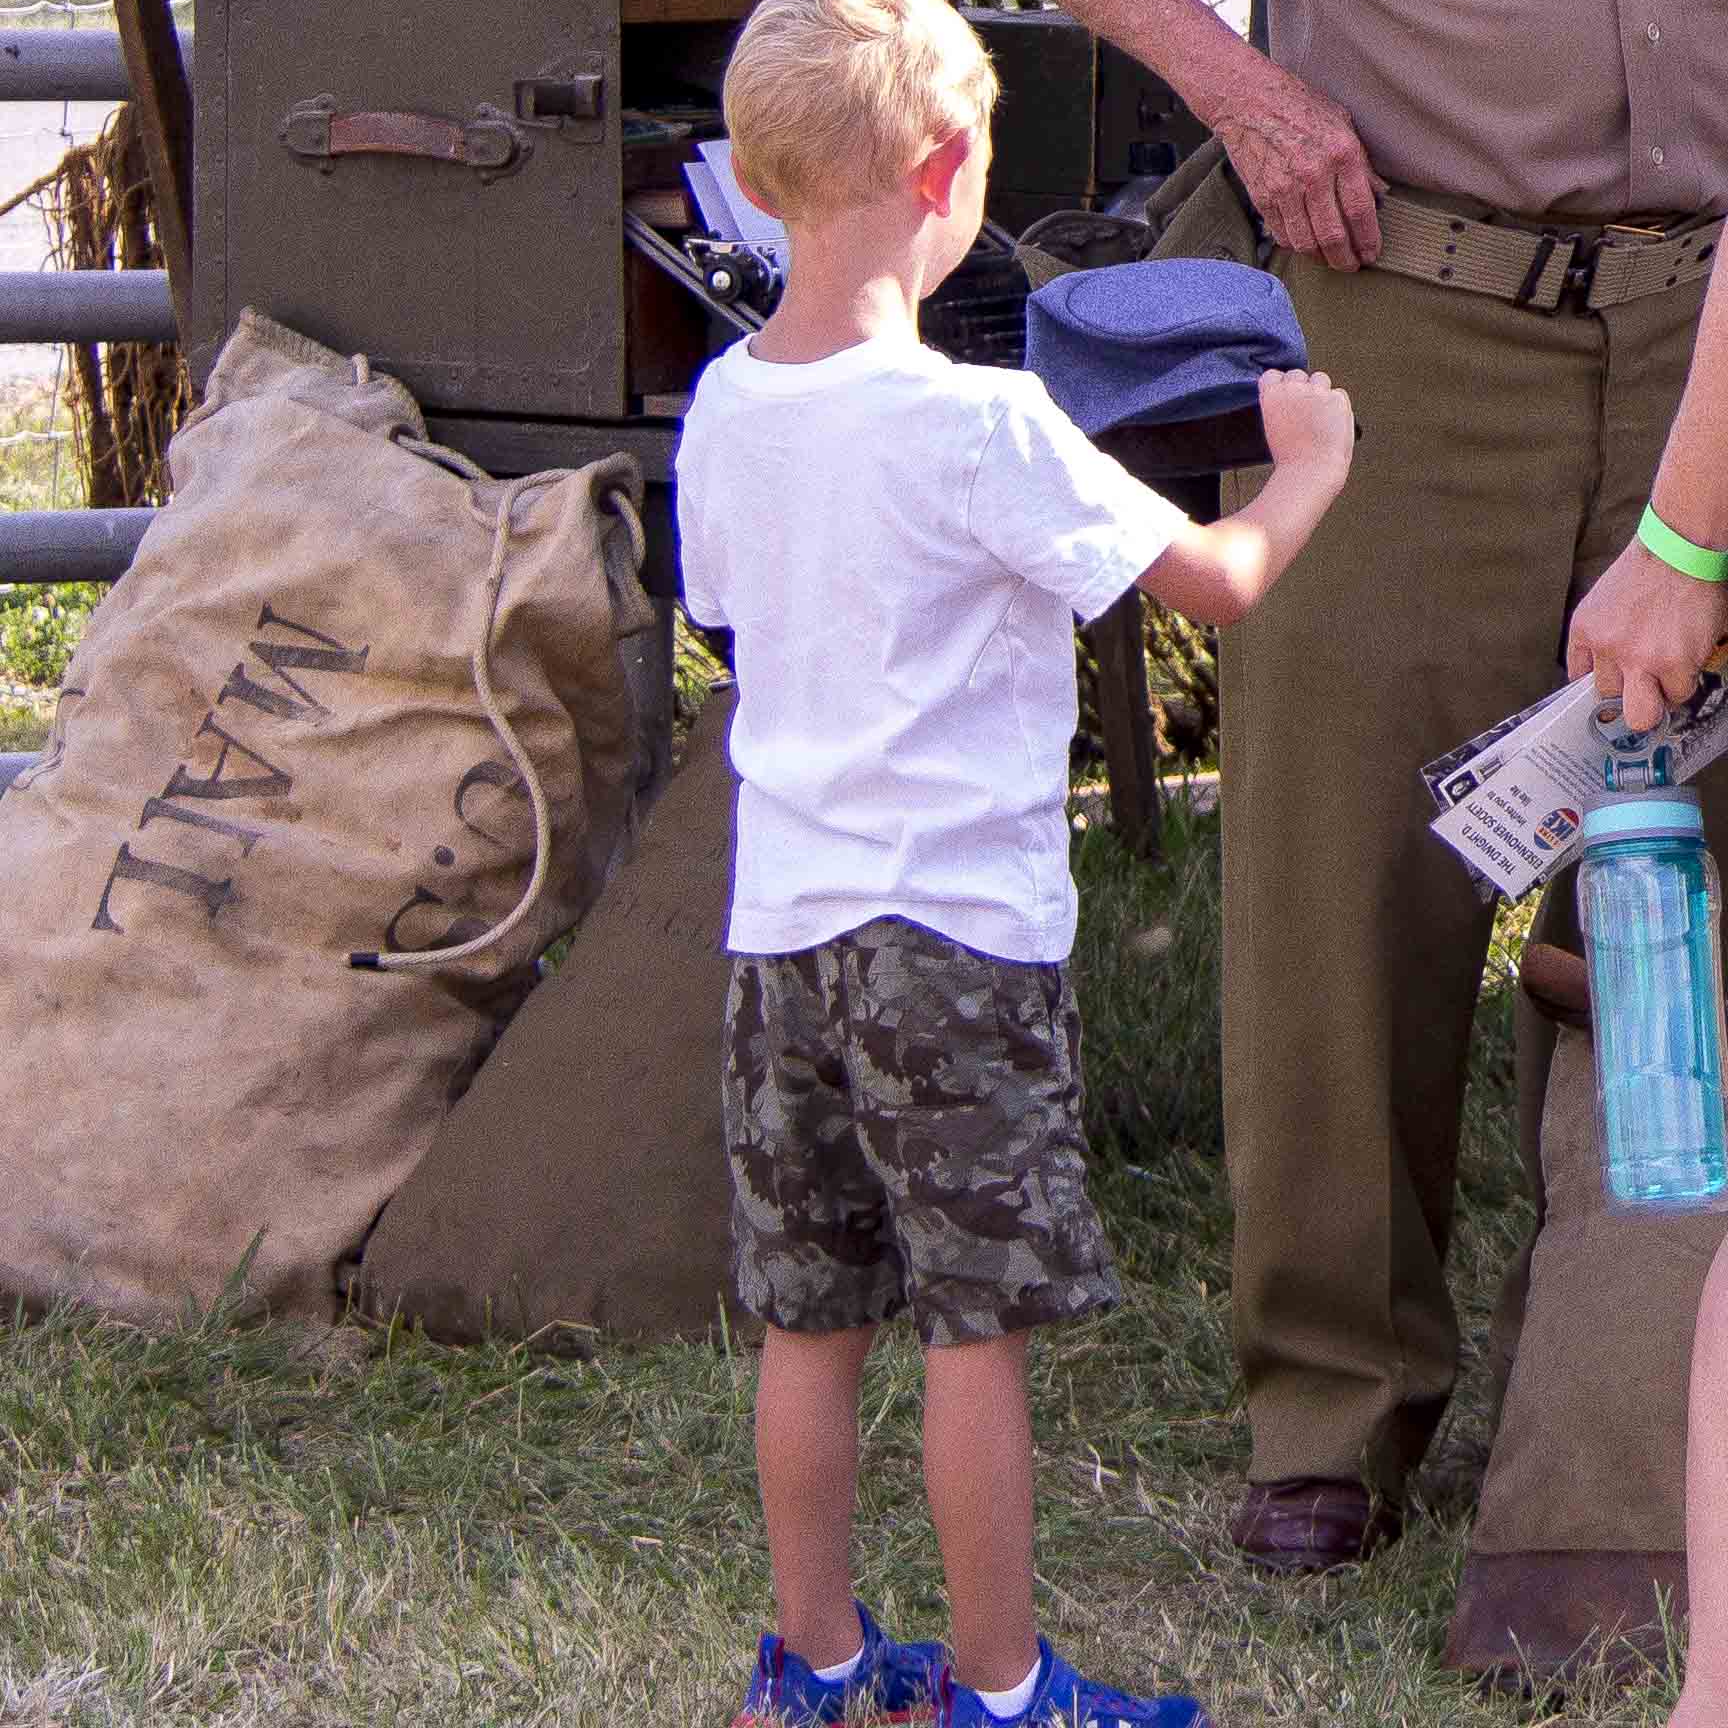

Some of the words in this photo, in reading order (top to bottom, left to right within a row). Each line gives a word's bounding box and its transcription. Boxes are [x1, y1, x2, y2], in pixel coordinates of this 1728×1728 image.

[91, 601, 370, 936] MAIL
[1465, 801, 1495, 829] SOCIETY
[1493, 796, 1508, 814] you
[1542, 809, 1576, 842] IKE
[1469, 828, 1503, 862] DWIGHT
[1492, 820, 1544, 870] EISENHOWER
[1500, 854, 1518, 876] THE
